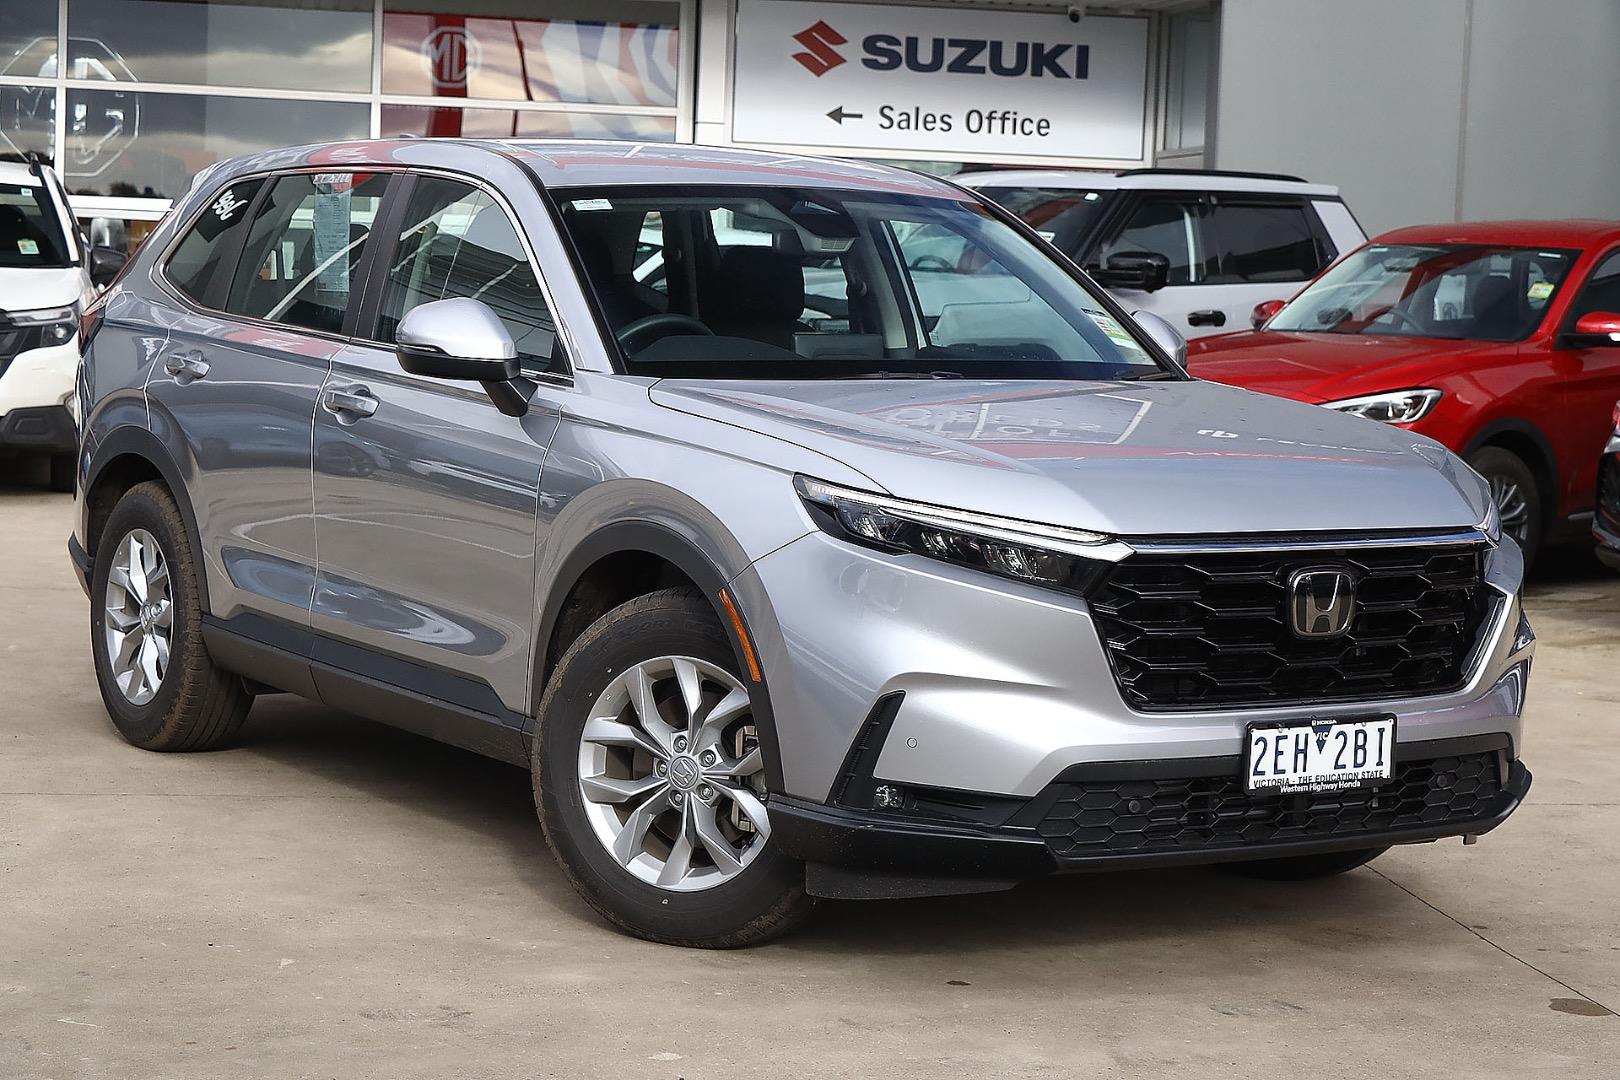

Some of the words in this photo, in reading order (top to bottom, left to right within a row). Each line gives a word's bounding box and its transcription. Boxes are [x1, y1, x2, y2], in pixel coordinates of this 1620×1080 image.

[861, 34, 1090, 80] SUZUKI
[878, 105, 953, 133] Sales
[965, 108, 1051, 137] Office
[1253, 733, 1309, 776] 2EH
[1333, 727, 1386, 770] 2BI
[1253, 778, 1290, 788] VICTORIA
[1298, 776, 1313, 784] THE
[1315, 771, 1359, 783] EDUCATION
[1361, 770, 1384, 780] STATE
[1280, 783, 1308, 793] Western
[1309, 781, 1338, 792] Highway
[1338, 780, 1361, 788] Honda
